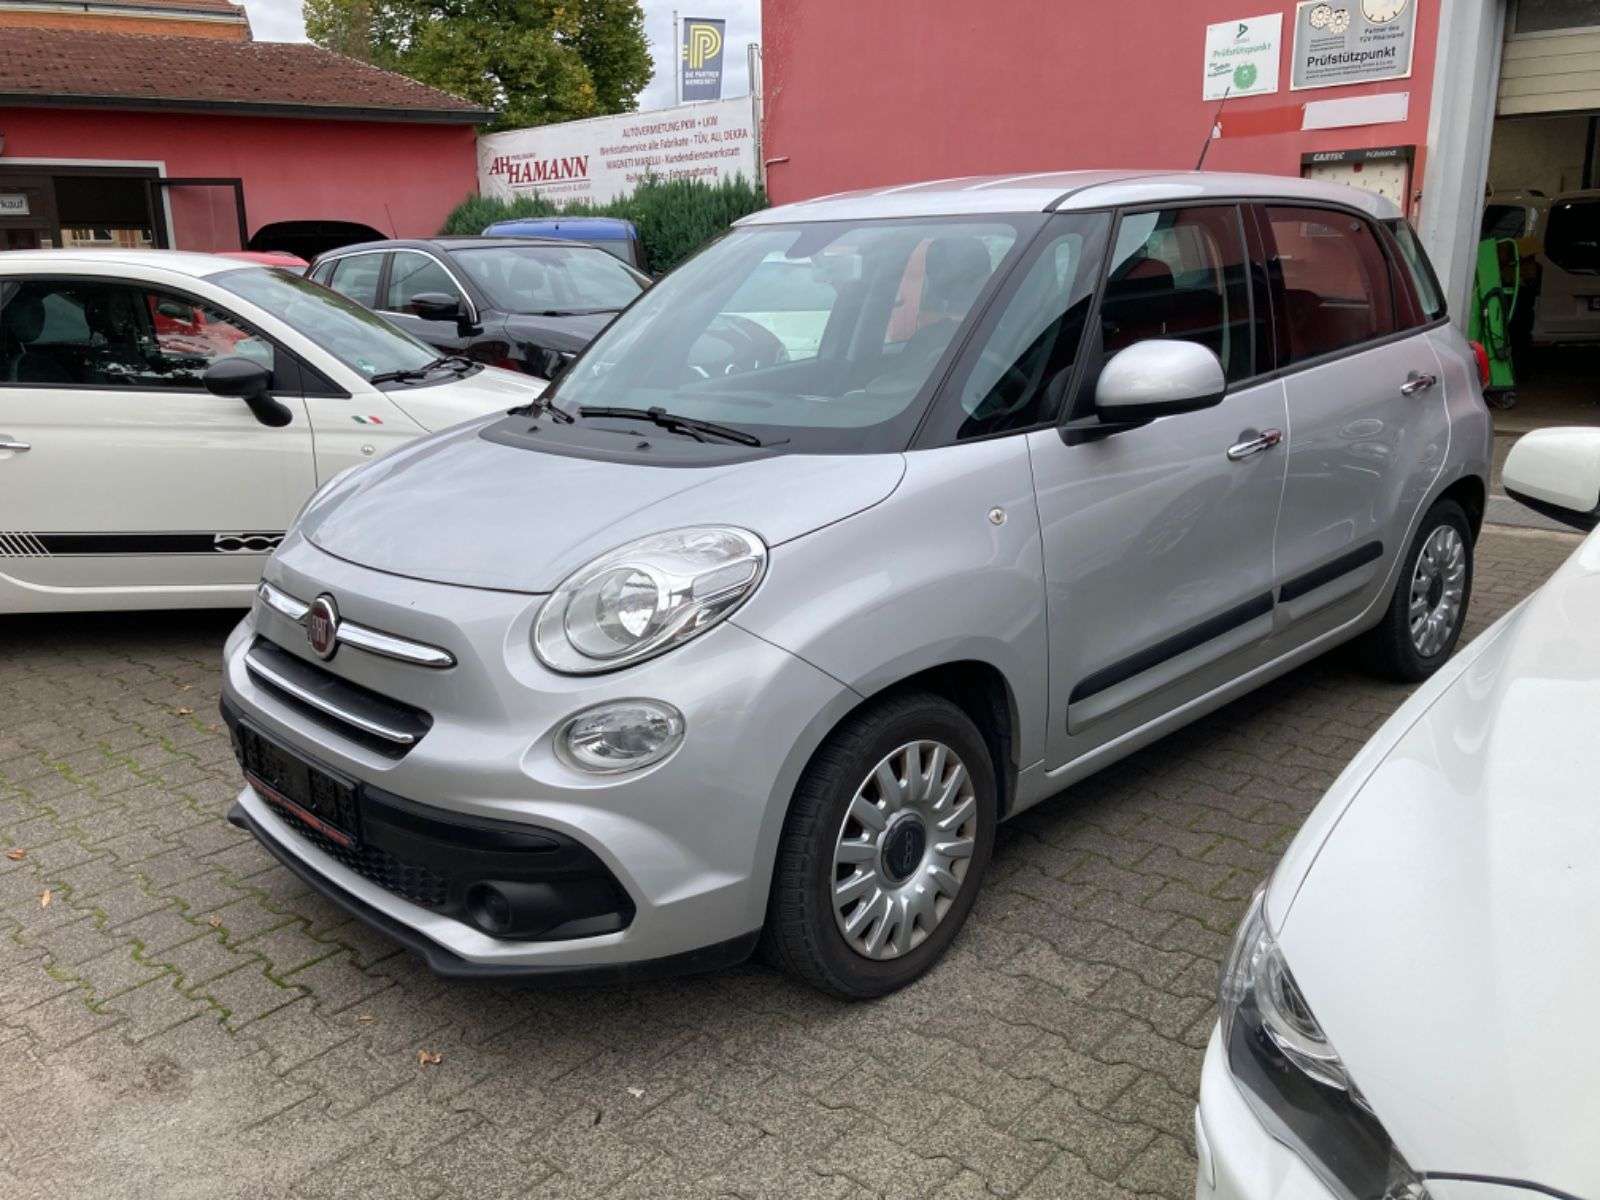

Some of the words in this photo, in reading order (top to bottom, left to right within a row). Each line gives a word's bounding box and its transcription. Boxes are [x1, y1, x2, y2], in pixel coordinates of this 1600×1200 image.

[1307, 46, 1396, 67] Prüfstützpunkt
[724, 128, 749, 141] DEKRA
[508, 155, 589, 184] HAMANN
